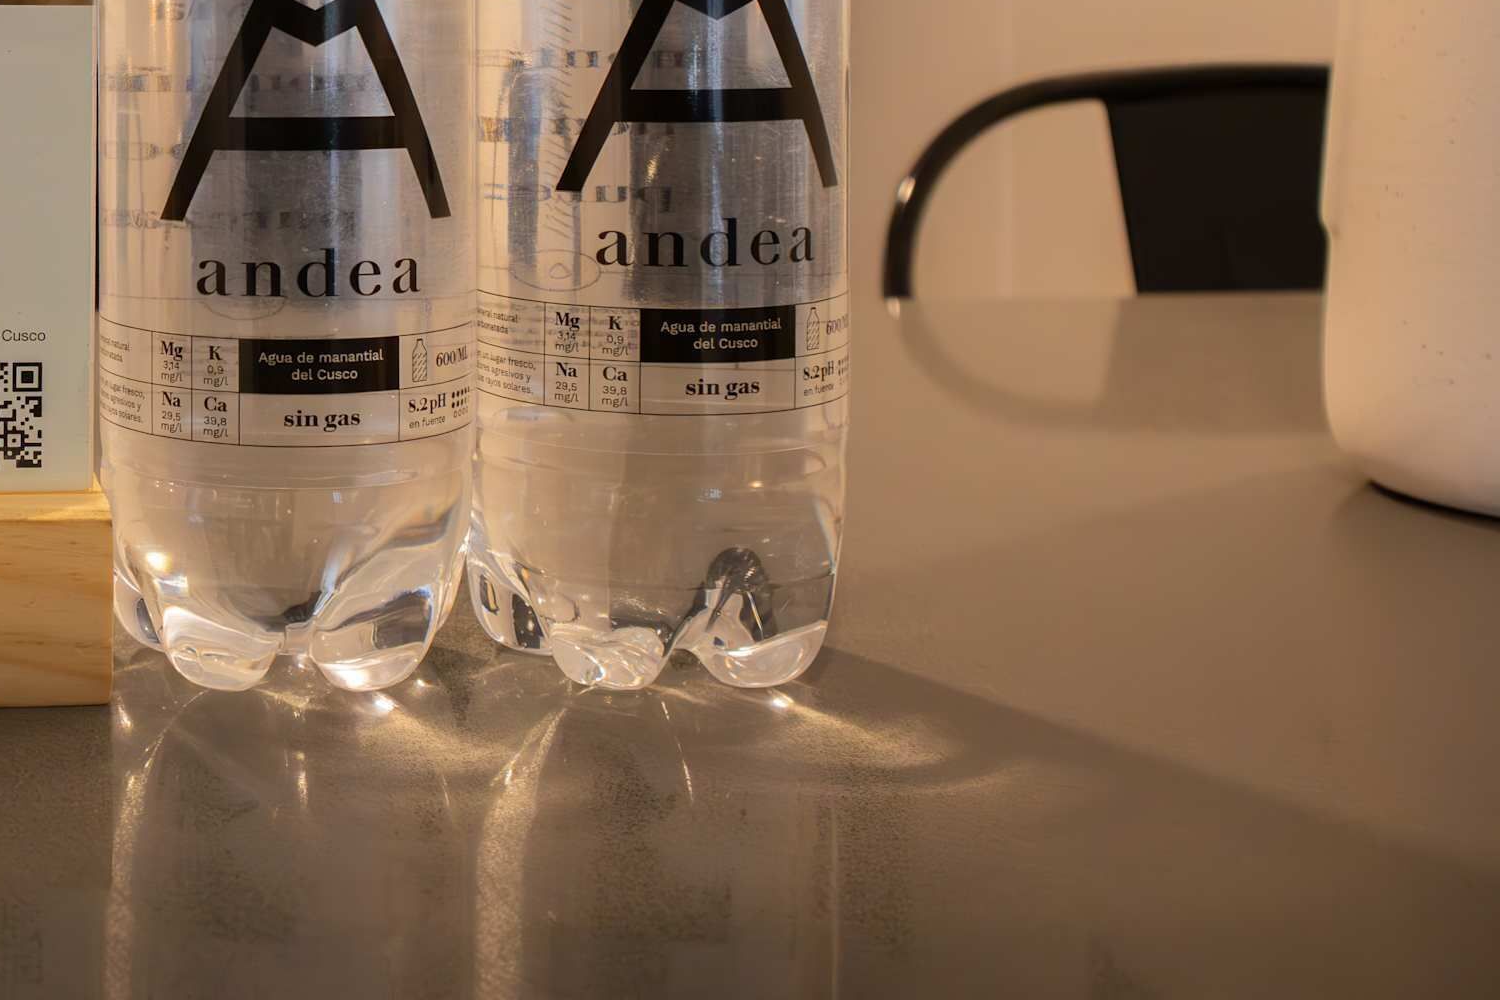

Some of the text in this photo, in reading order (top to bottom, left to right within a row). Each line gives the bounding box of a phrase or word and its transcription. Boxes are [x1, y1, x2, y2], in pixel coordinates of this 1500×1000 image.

[596, 218, 815, 268] andea
[196, 248, 421, 297] andea
[555, 312, 580, 331] Mg
[608, 316, 623, 331] K
[660, 318, 782, 336] Agua de manantial
[1, 330, 46, 342] Cusco
[693, 338, 759, 350] del Cusco
[160, 341, 183, 361] Mg
[208, 345, 222, 361] K
[258, 348, 384, 367] Agua de manantial
[291, 369, 359, 381] del Cusco
[555, 362, 578, 378] Na
[602, 366, 628, 382] Ca
[203, 376, 229, 388] mg/l
[685, 379, 761, 400] sin gas
[602, 385, 627, 396] 39,8
[162, 391, 181, 408] Na
[203, 396, 227, 413] Ca
[601, 397, 628, 409] mg/l
[203, 416, 227, 427] 39,8
[283, 410, 361, 432] sin gas
[203, 427, 229, 439] mg/l
